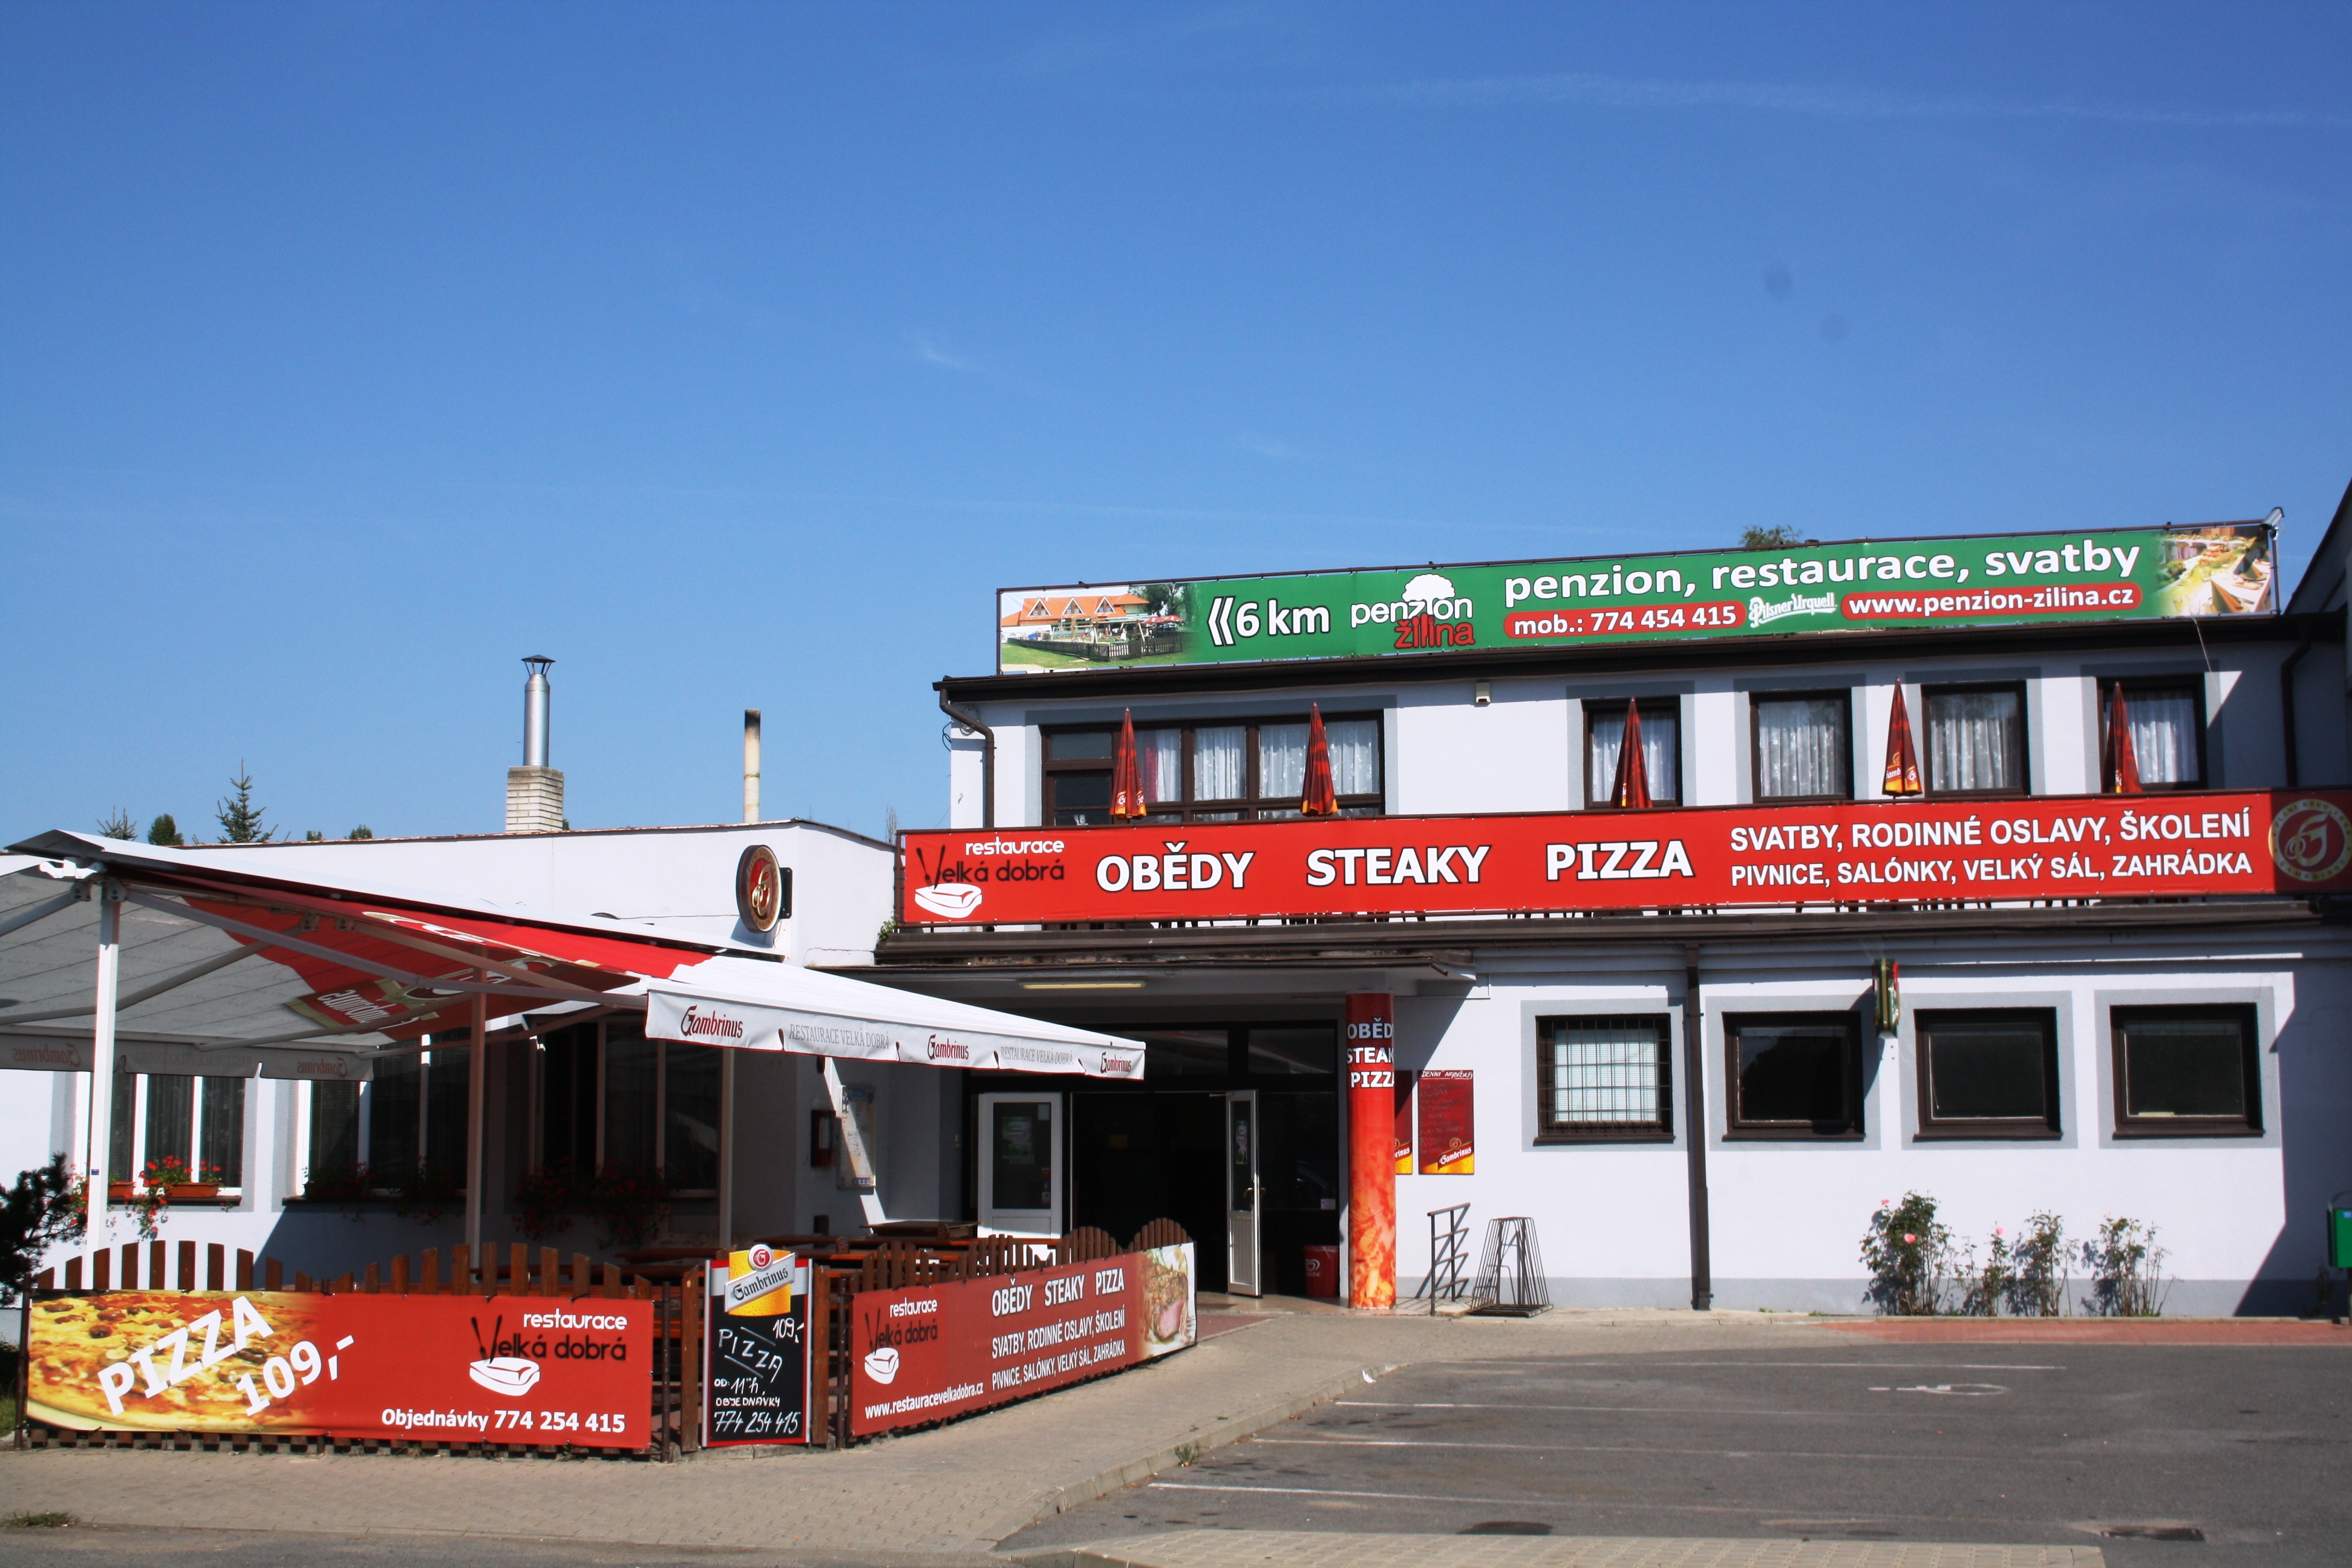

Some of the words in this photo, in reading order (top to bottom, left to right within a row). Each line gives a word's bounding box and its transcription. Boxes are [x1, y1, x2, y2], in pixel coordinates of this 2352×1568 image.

[1504, 564, 1696, 608] penzion,
[1711, 552, 1970, 591] restaurace,
[1985, 539, 2140, 577] svatby
[1748, 596, 1793, 629] Pilsner
[1791, 592, 1835, 616] Urquell
[1849, 585, 2134, 616] www.penzion-zilina.cz
[1236, 602, 1260, 636] 6
[1268, 599, 1330, 636] km
[1514, 613, 1583, 635] mob.:
[1591, 611, 1635, 632] 774
[1641, 608, 1685, 629] 454
[1691, 606, 1736, 626] 415
[1731, 823, 1843, 852] SVATBY,
[1852, 815, 1982, 848] RODINNÉ
[1990, 816, 2111, 846] OSLAVY,
[2119, 807, 2250, 841] ŠKOLENÍ
[965, 837, 1065, 855] restaurace
[996, 858, 1065, 882] dobrá
[1096, 841, 1255, 893] OBĚDY
[1307, 845, 1492, 887] STEAKY
[1546, 839, 1694, 881] PIZZA
[1731, 863, 1831, 888] PIVNICE,
[1837, 857, 1956, 885] SALÓNKY,
[1962, 852, 2043, 881] VELKÝ
[2050, 852, 2105, 881] SÁL,
[2112, 848, 2252, 877] ZAHRÁDKA
[681, 1004, 743, 1038] Gambrinus
[788, 1023, 840, 1045] RESTAURACE
[840, 1027, 864, 1047] VELKÁ
[866, 1031, 889, 1050] DOBRÁ
[927, 1033, 969, 1060] Gambrinus
[1000, 1046, 1036, 1063] RESTAURACE
[1036, 1047, 1054, 1064] VELKÁ
[1055, 1050, 1073, 1065] DOBRÁ
[1100, 1051, 1132, 1074] Gambrinus
[1347, 1017, 1394, 1039] OBĚD
[1347, 1047, 1394, 1064] STEAK
[1351, 1071, 1394, 1088] PIZZ
[1394, 1147, 1410, 1158] rinus
[1439, 1146, 1472, 1165] Gambrinus
[731, 1269, 789, 1301] Gambrinus
[992, 1278, 1033, 1317] OBĚDY
[1044, 1274, 1085, 1307] STEAKY
[1096, 1268, 1125, 1295] PIZZA
[523, 1308, 627, 1330] restaurace
[890, 1297, 937, 1318] restaurace
[905, 1318, 937, 1344] dobrá
[992, 1331, 1025, 1359] SVATBY,
[1027, 1319, 1062, 1351] RODINNÉ
[1064, 1315, 1094, 1342] OSLAVY,
[1095, 1304, 1125, 1333] ŠKOLENÍ
[97, 1295, 273, 1416] PIZZA
[555, 1334, 626, 1361] dobrá
[719, 1328, 783, 1383] PIZZA
[236, 1335, 354, 1416] 109,-
[992, 1367, 1022, 1391] PIVNICE,
[1024, 1357, 1056, 1383] SALÓNKY,
[1057, 1348, 1078, 1373] VELKÝ
[1079, 1345, 1093, 1367] SÁL,
[1093, 1339, 1125, 1362] ZAHRÁDKA
[864, 1382, 984, 1419] www.restauracevelkadobra.cz
[382, 1408, 489, 1431] Objednávky
[494, 1410, 533, 1429] 774
[540, 1411, 580, 1432] 254
[585, 1413, 625, 1434] 415
[714, 1410, 743, 1433] 774
[745, 1411, 772, 1433] 254
[776, 1411, 801, 1434] 415
